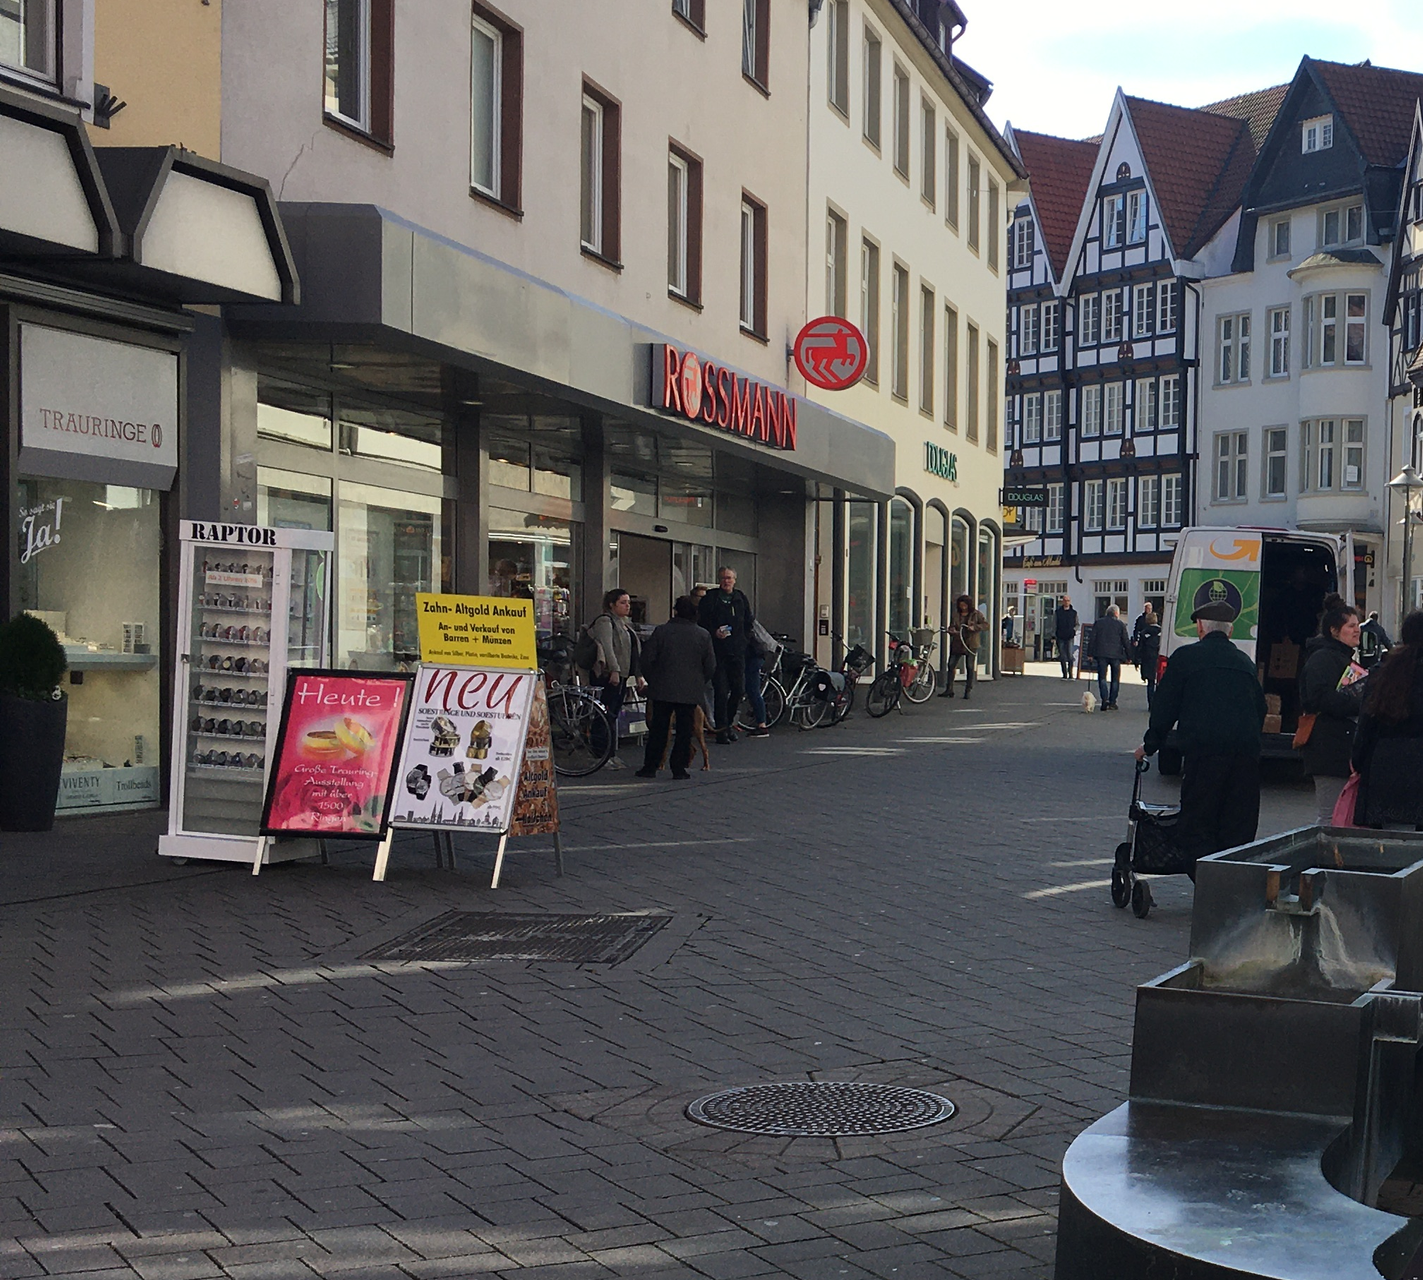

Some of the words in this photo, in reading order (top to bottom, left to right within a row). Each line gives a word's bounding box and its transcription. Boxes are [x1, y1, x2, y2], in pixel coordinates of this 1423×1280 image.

[663, 343, 797, 451] ROSSMANN
[39, 407, 147, 444] TRAURINGE
[1007, 493, 1044, 501] DOUGLAS
[21, 498, 63, 564] Ja!
[191, 522, 277, 546] RAPTOR
[423, 602, 452, 613] Zahn-
[455, 603, 490, 618] Altgold
[492, 605, 527, 618] Ankauf
[438, 622, 451, 631] An-
[453, 623, 468, 632] und
[470, 624, 500, 633] Verkauf
[444, 633, 469, 643] Barren
[482, 635, 512, 645] Münzen
[298, 683, 381, 708] Heute
[393, 687, 401, 708] !
[424, 668, 523, 719] neu
[294, 764, 327, 774] Große
[330, 765, 378, 778] Trauring-
[62, 776, 100, 789] VIVENTY
[116, 778, 152, 791] Trollbeads
[304, 776, 364, 789] Ausstellung
[311, 789, 327, 798] mit
[329, 789, 352, 799] über
[318, 801, 344, 810] 1500
[310, 812, 346, 824] Ringen
